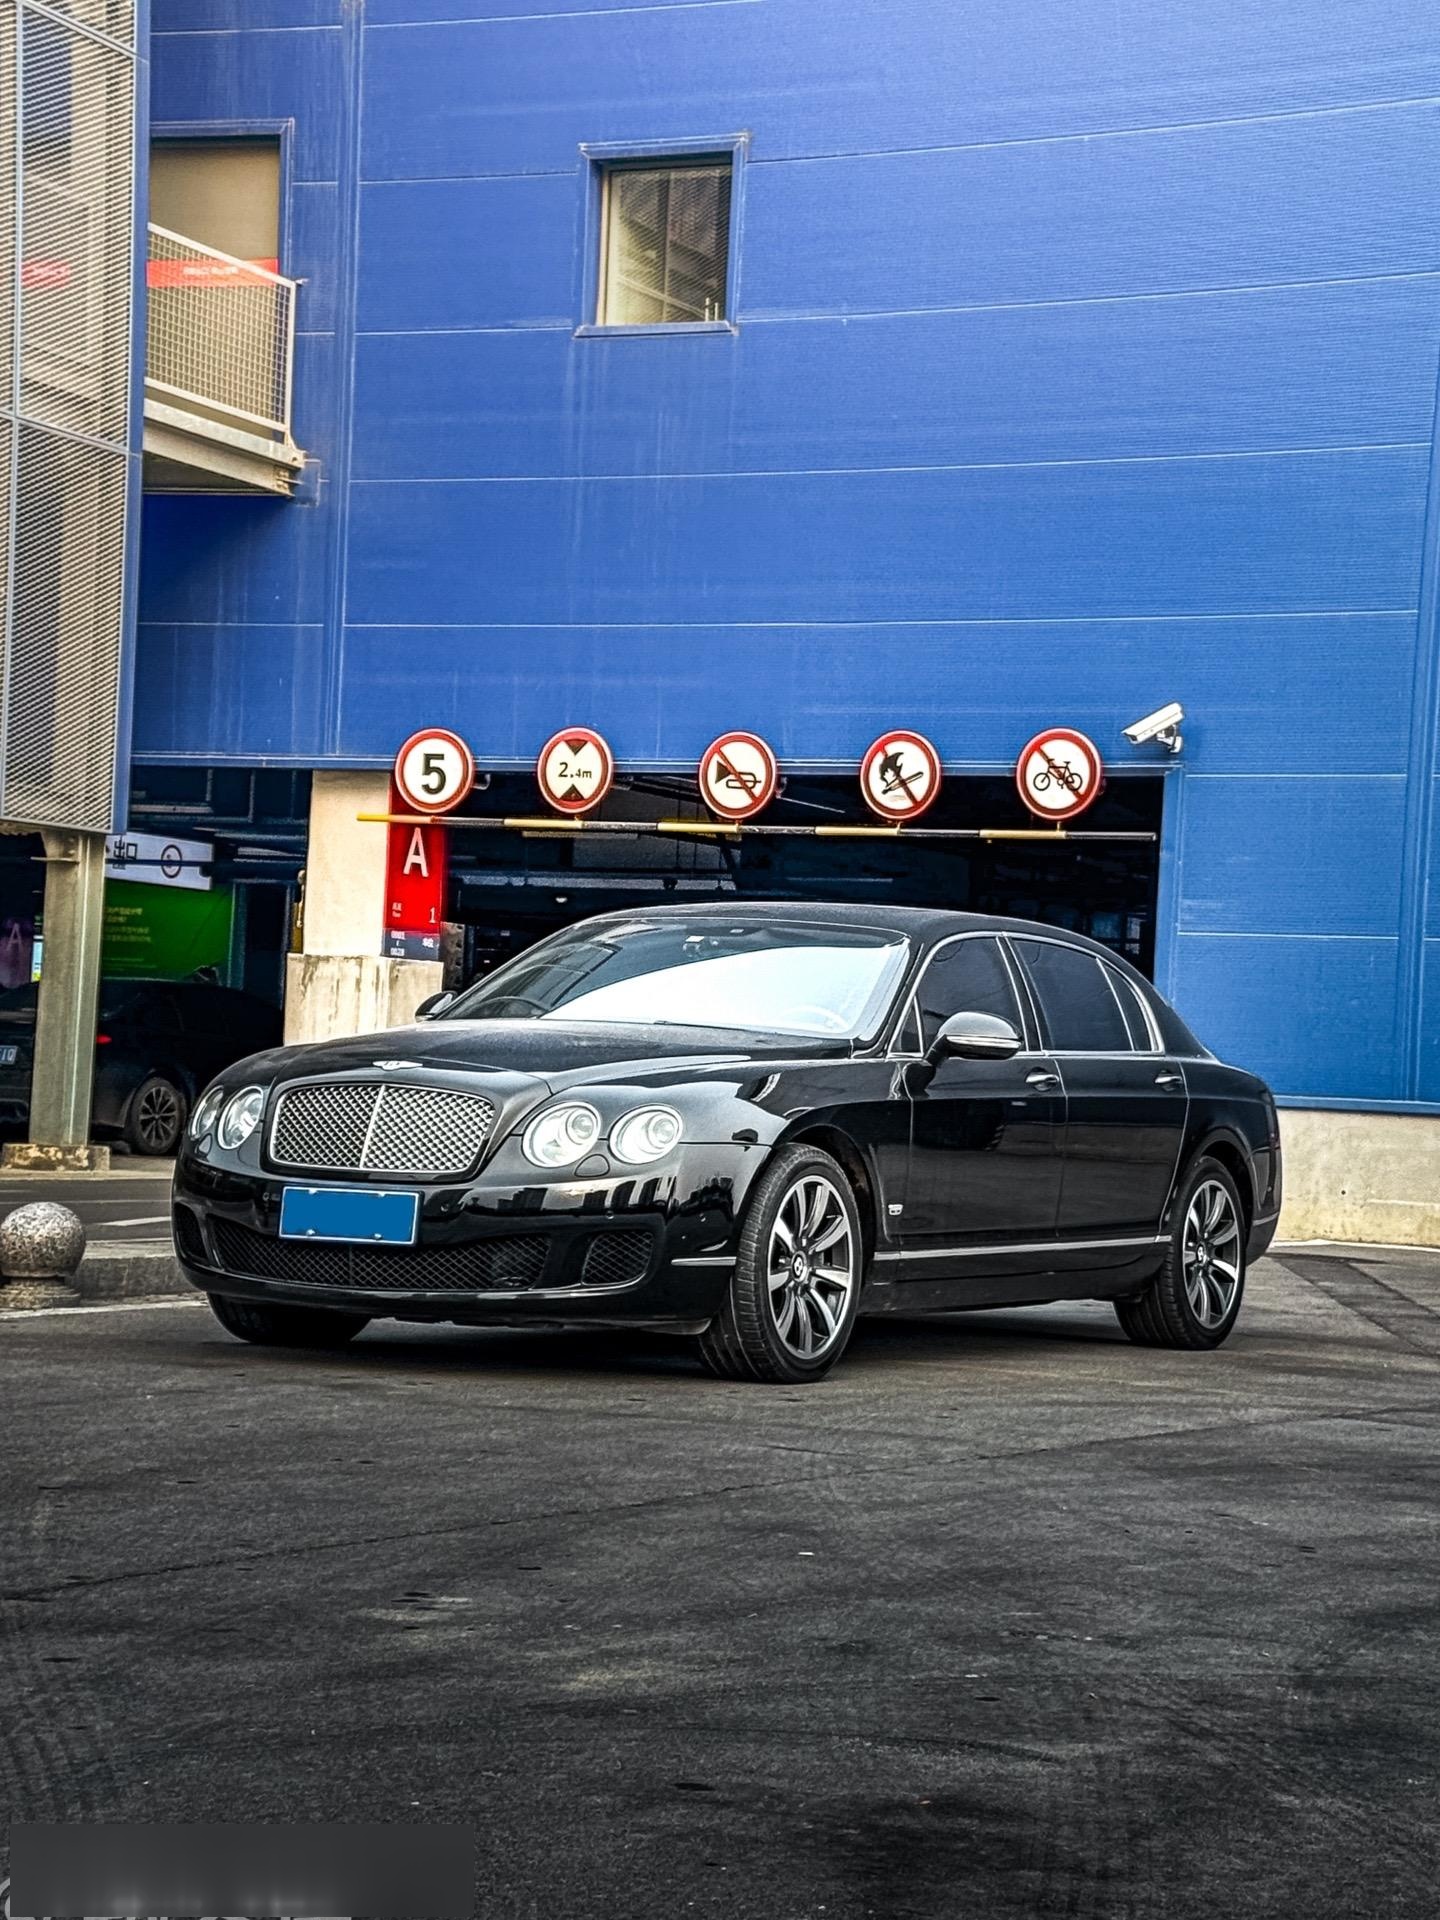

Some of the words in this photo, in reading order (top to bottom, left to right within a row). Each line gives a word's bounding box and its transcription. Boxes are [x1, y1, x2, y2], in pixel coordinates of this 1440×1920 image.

[422, 753, 446, 795] 5
[558, 761, 592, 779] 2.4m
[113, 836, 138, 860] 出口
[403, 827, 429, 877] A
[429, 906, 436, 923] 1
